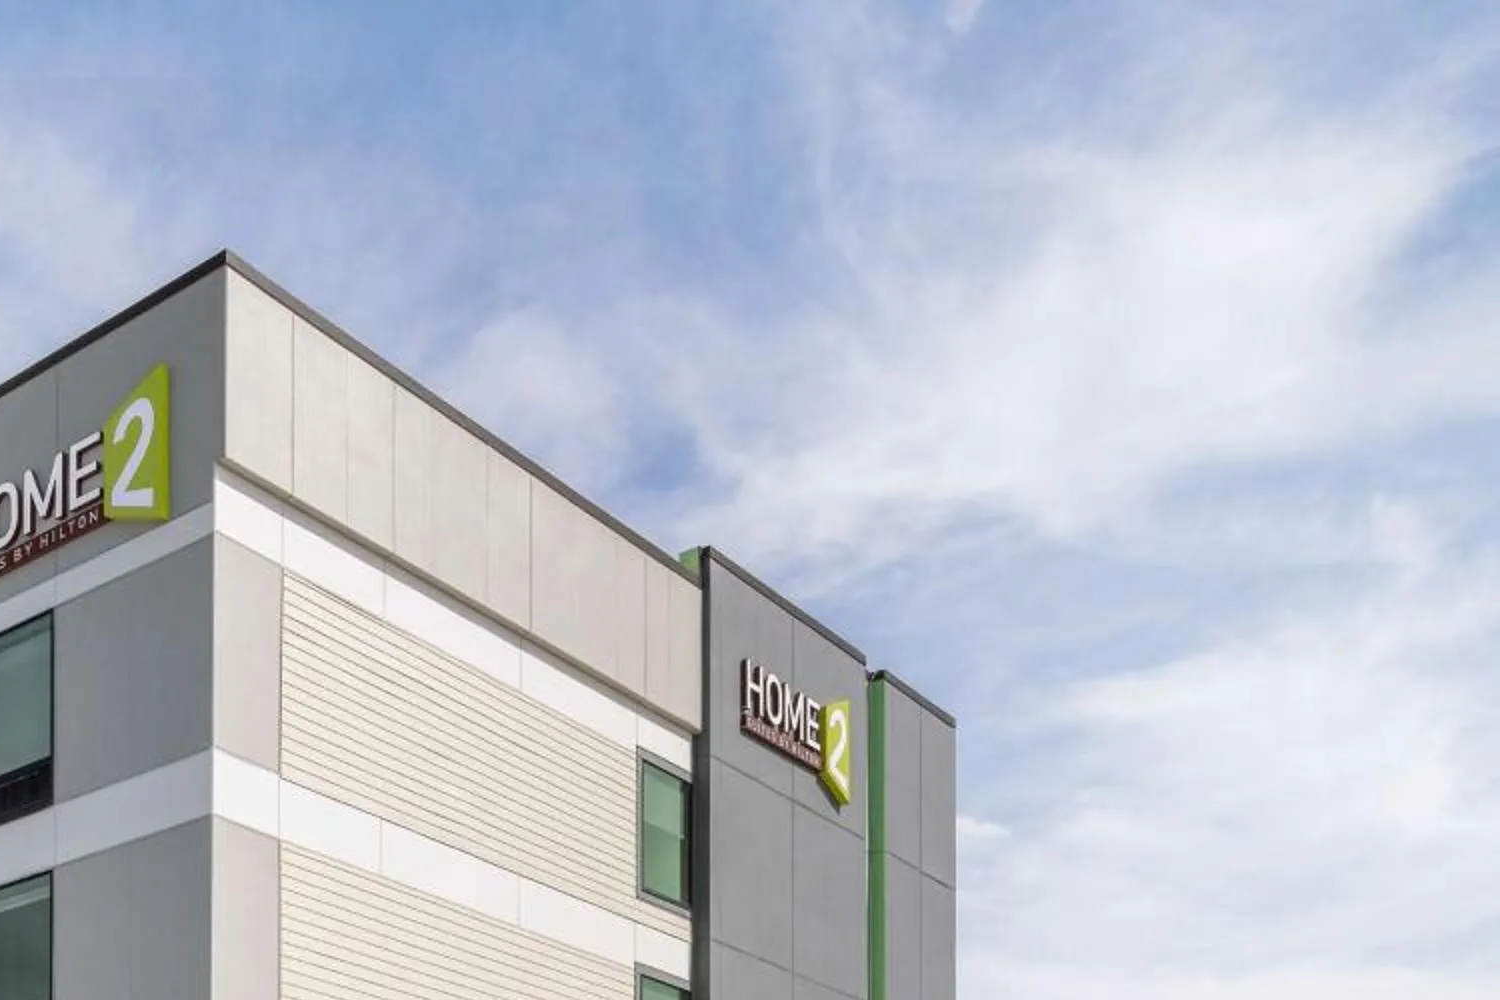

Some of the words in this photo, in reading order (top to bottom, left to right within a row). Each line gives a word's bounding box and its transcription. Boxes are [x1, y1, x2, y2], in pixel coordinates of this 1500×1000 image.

[112, 397, 155, 508] 2
[13, 542, 33, 562] BY
[39, 510, 100, 550] HILTON
[746, 659, 821, 750] HOME
[829, 709, 849, 792] 2
